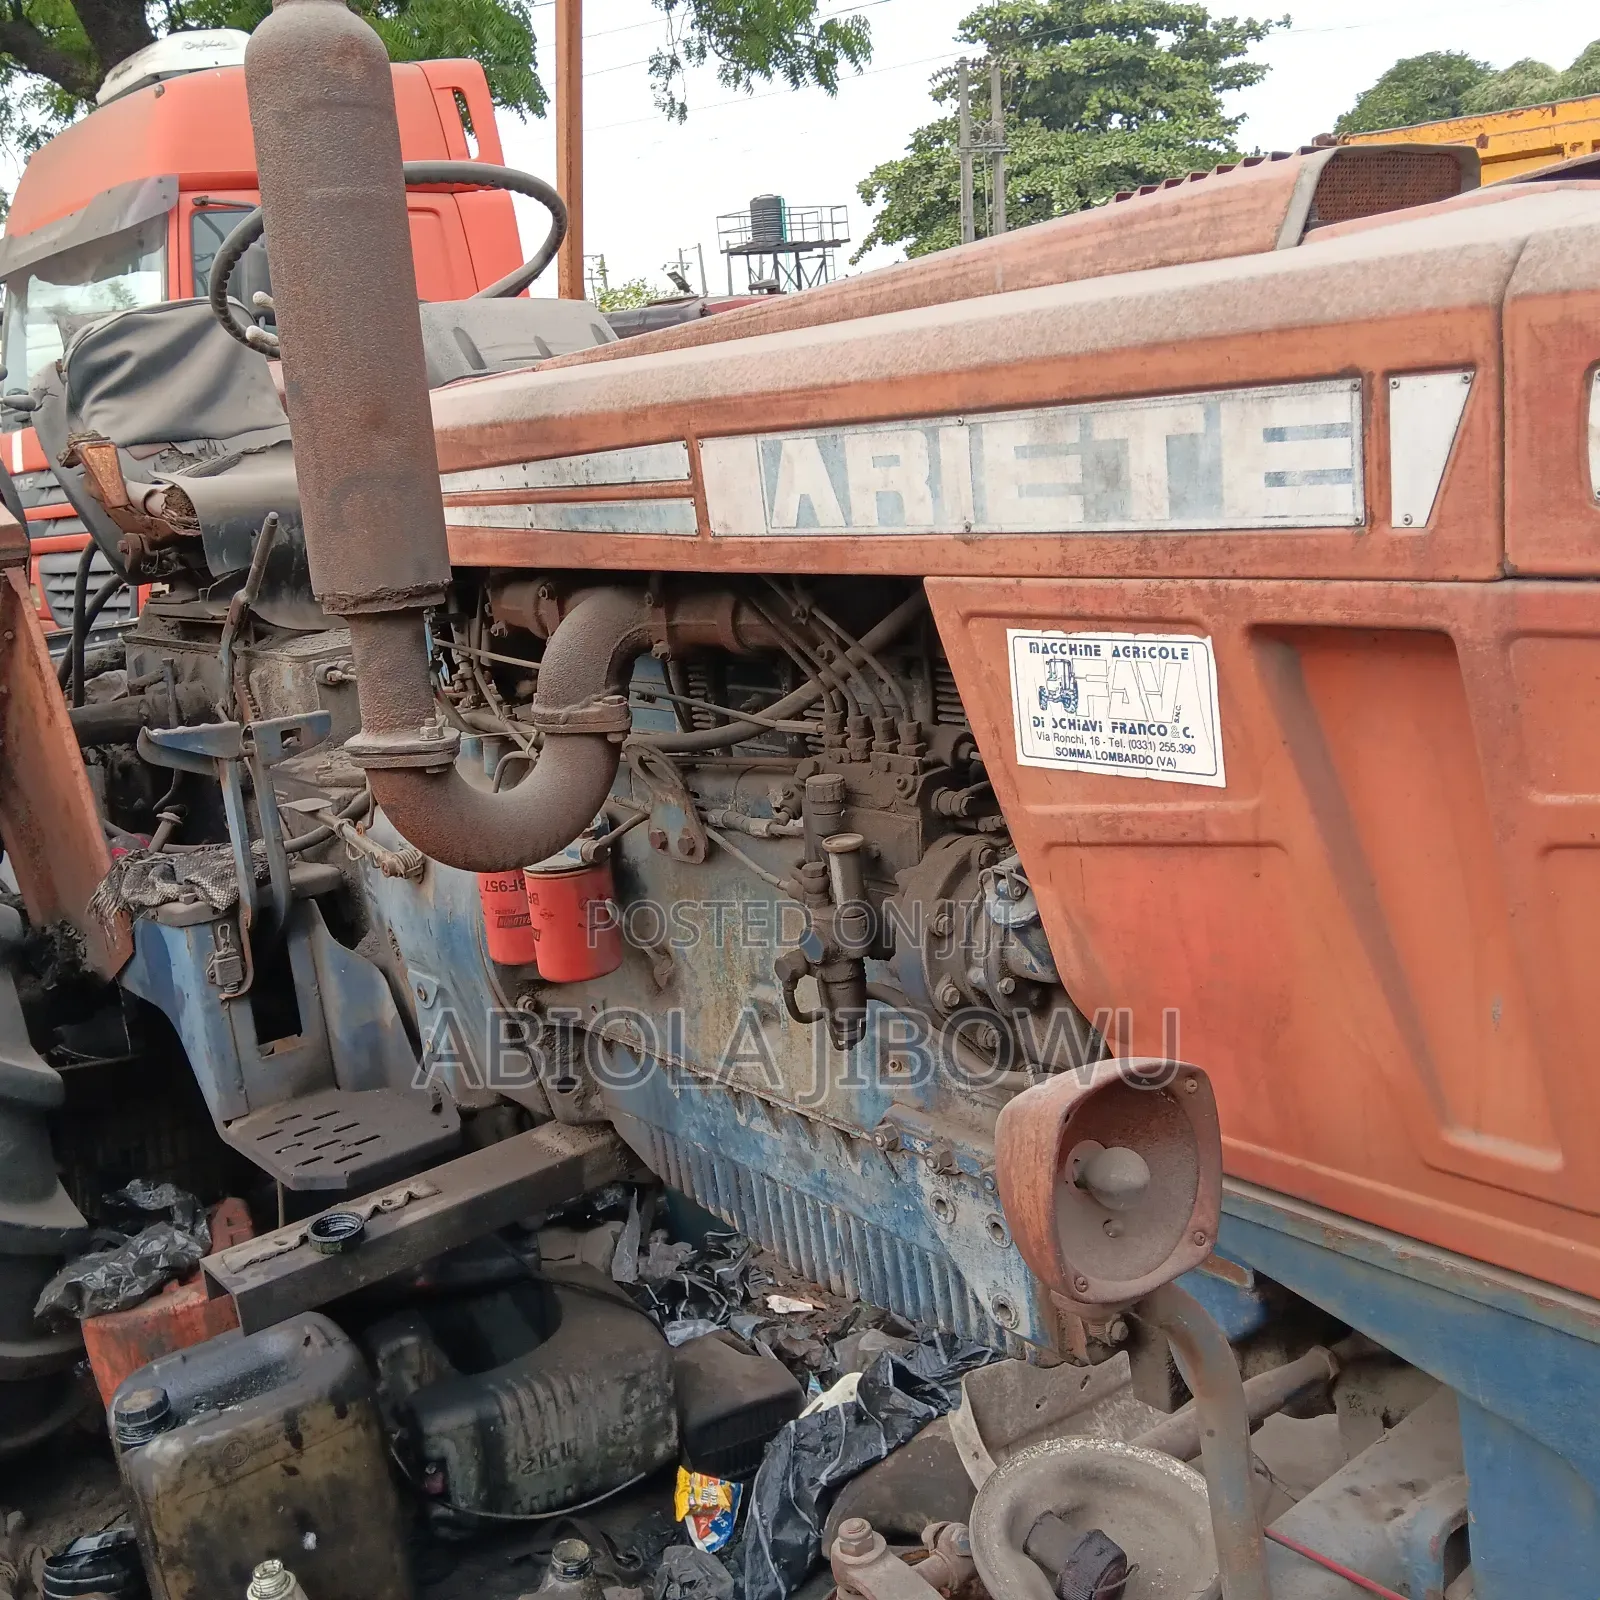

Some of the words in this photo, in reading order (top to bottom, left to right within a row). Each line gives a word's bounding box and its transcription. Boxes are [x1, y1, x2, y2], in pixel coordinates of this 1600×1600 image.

[766, 396, 1353, 526] ARIETE
[1111, 721, 1168, 737] FRANCO
[1182, 726, 1195, 739] C.
[1036, 731, 1051, 742] Via
[1053, 732, 1087, 746] Ronchi,
[1089, 735, 1101, 746] 16
[1108, 737, 1126, 749] Tel.
[1128, 739, 1156, 753] (0331)
[1159, 741, 1196, 755] 255.390
[1055, 746, 1093, 760] SOMMA
[1095, 750, 1154, 766] LOMBARDO
[1156, 756, 1177, 769] (VA)
